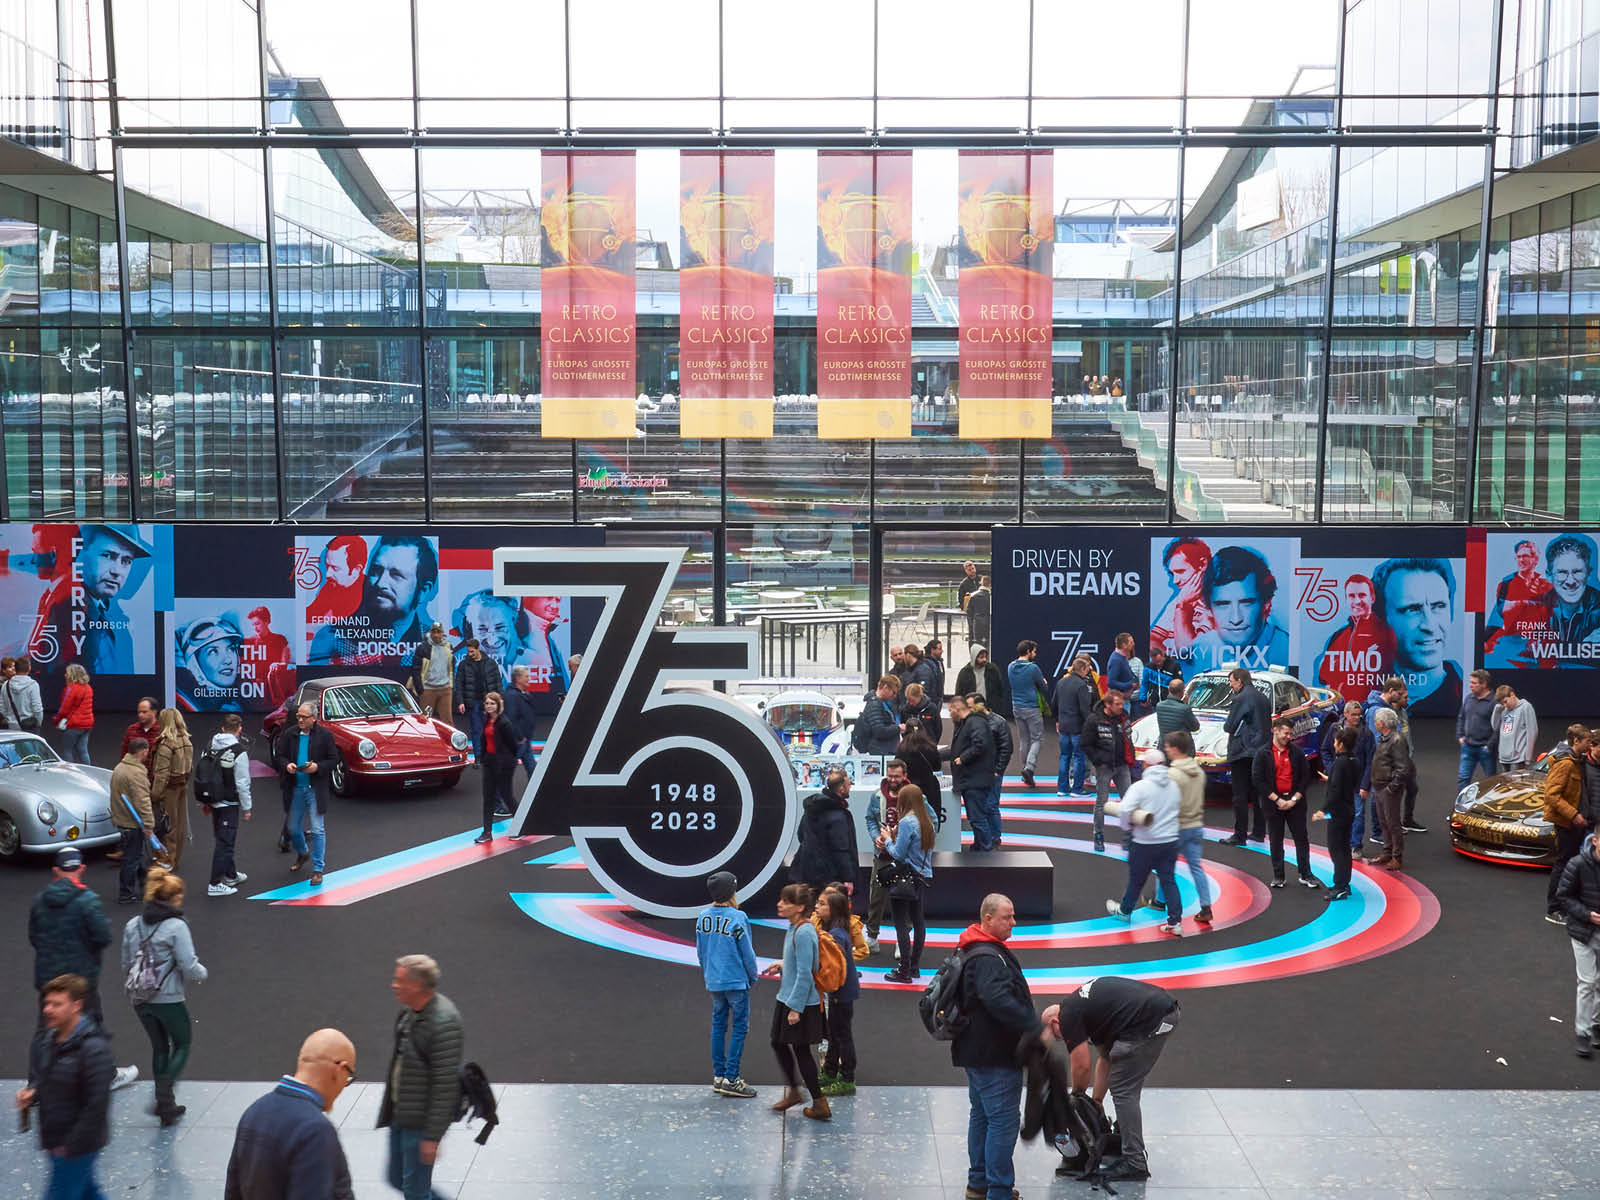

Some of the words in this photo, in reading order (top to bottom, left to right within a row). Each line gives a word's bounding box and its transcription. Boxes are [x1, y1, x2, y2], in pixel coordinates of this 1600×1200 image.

[562, 304, 617, 321] RETRO
[702, 305, 755, 321] RETRO
[838, 305, 892, 321] RETRO
[980, 304, 1034, 321] RETRO
[547, 360, 588, 368] EUROPAS
[592, 359, 631, 368] GRÖSSTE
[687, 360, 727, 369] EUROPAS
[730, 359, 769, 369] GRÖSSTE
[824, 360, 864, 369] EUROPAS
[867, 359, 906, 369] GRÖSSTE
[966, 360, 1006, 369] EUROPAS
[1009, 359, 1047, 369] GRÖSSTE
[552, 372, 626, 380] OLDTIMERMESSE
[691, 372, 765, 381] OLDTIMERMESSE
[828, 372, 902, 381] OLDTIMERMESSE
[970, 372, 1042, 381] OLDTIMERMESSE
[1012, 549, 1082, 568] DRIVEN
[1089, 549, 1113, 568] BY
[287, 547, 322, 590] 75
[1029, 572, 1141, 596] DREAMS
[71, 537, 86, 656] FERRY
[1294, 567, 1340, 623] 75
[89, 621, 130, 630] PORSCH
[311, 616, 370, 626] FERDINAND
[1516, 621, 1547, 630] FRANK
[19, 614, 59, 664] 75
[334, 628, 395, 639] ALEXANDER
[1520, 631, 1560, 640] STEFFEN
[240, 644, 267, 661] THI
[358, 641, 421, 656] PORSCH
[1531, 642, 1600, 659] WALLISE
[1211, 645, 1270, 669] ICKX
[1326, 644, 1382, 672] TIMÓ
[240, 663, 256, 679] RI
[193, 687, 239, 698] GILBERTE
[240, 681, 265, 698] ON
[493, 547, 797, 919] 75
[651, 783, 717, 802] 1948
[651, 811, 718, 831] 2023
[1491, 821, 1541, 839] EXPRESS
